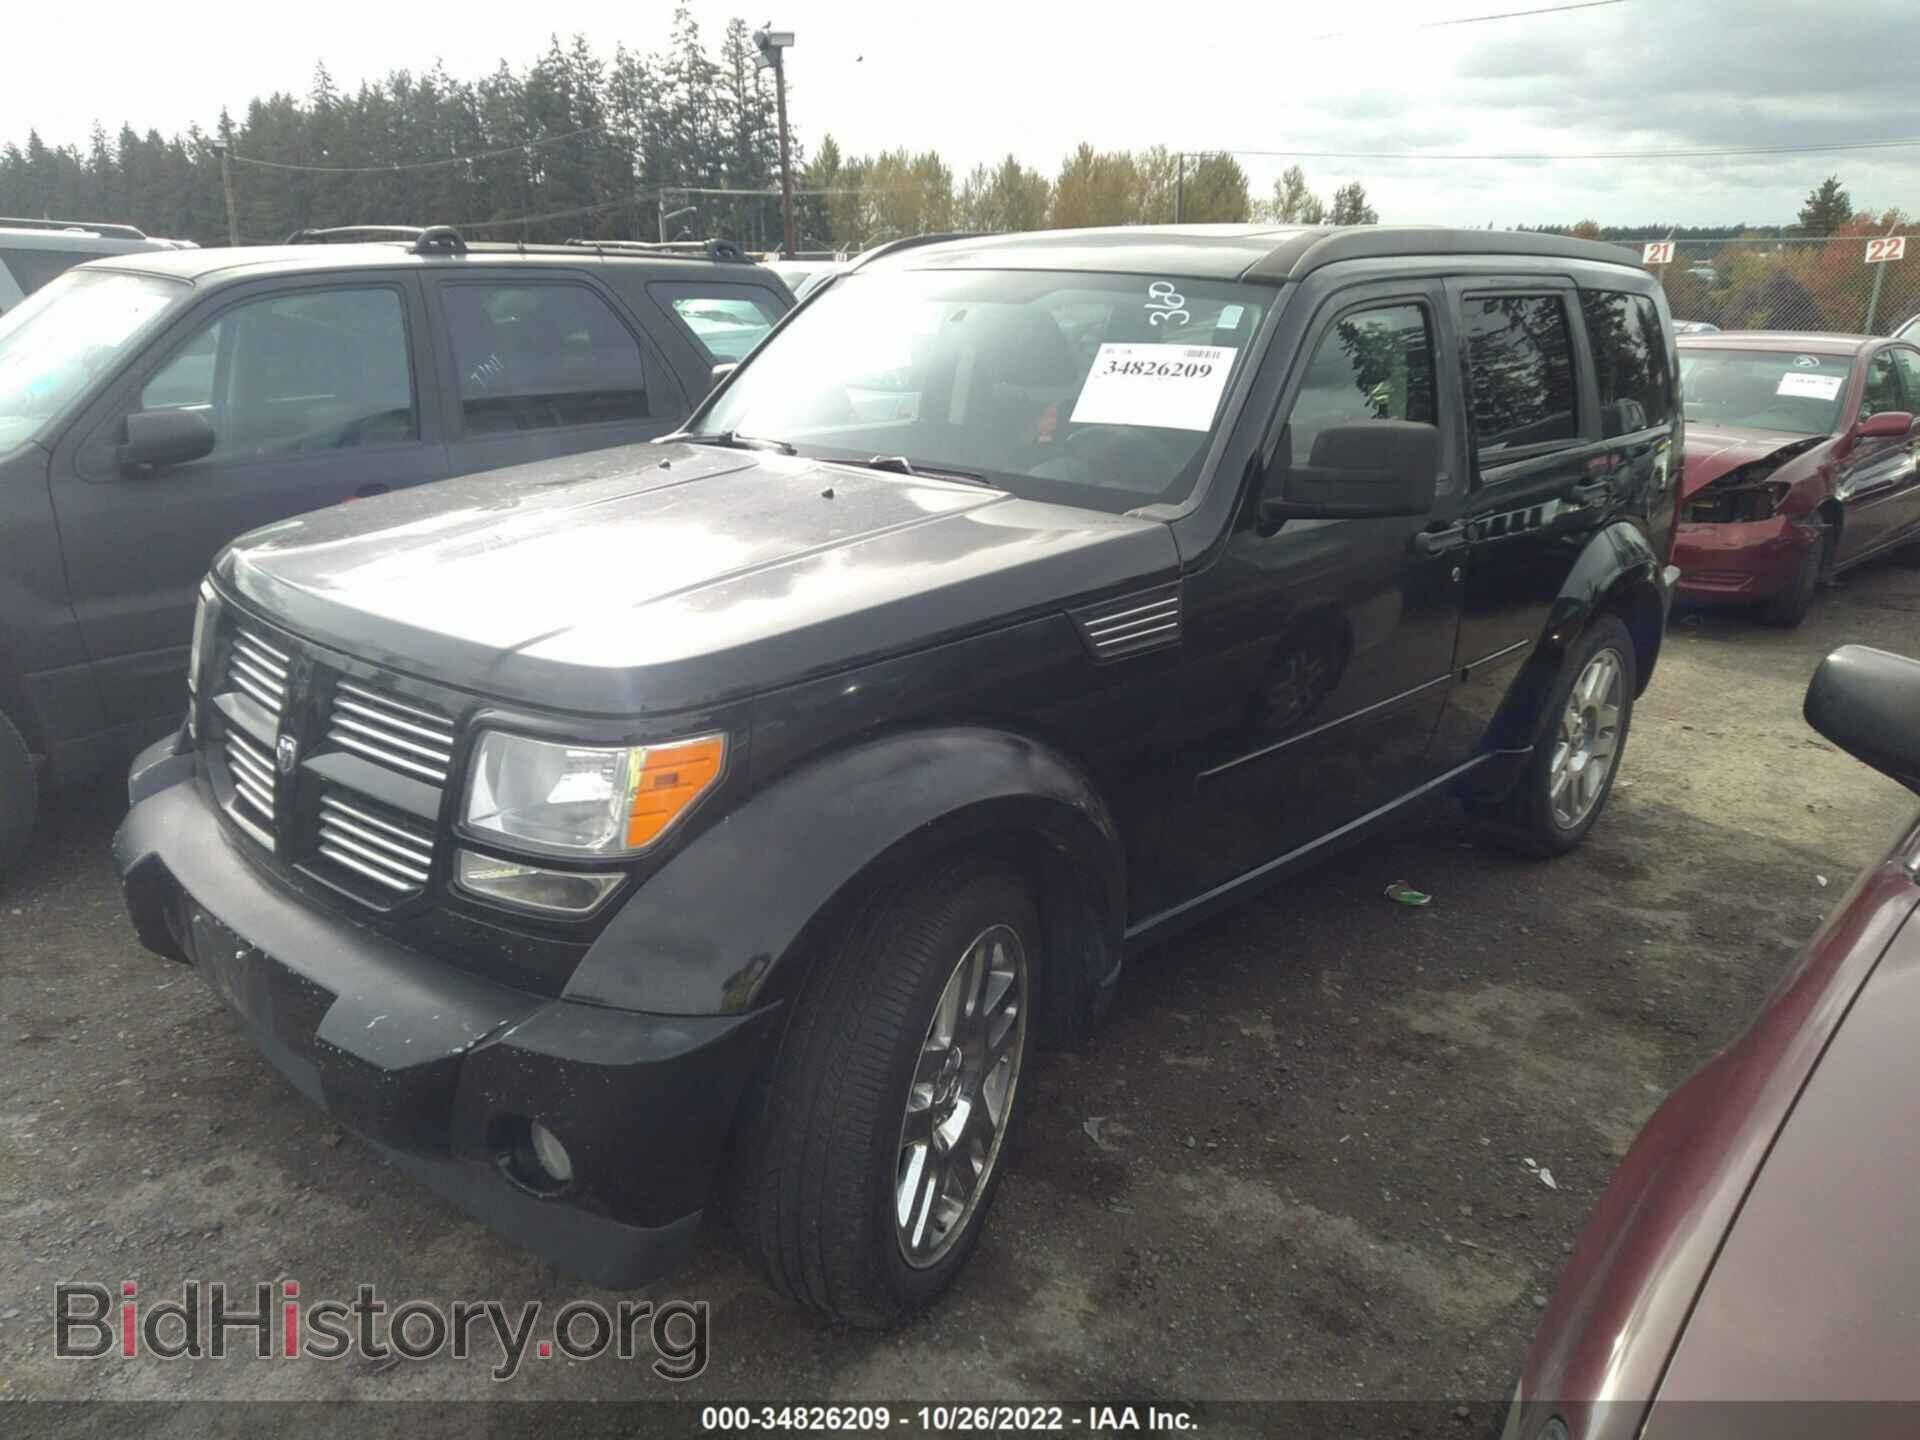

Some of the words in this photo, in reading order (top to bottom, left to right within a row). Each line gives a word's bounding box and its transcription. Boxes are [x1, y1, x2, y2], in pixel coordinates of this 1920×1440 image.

[1647, 244, 1669, 262] 21
[1870, 239, 1902, 260] 22
[1144, 281, 1190, 326] 360
[1103, 359, 1213, 378] 34826209
